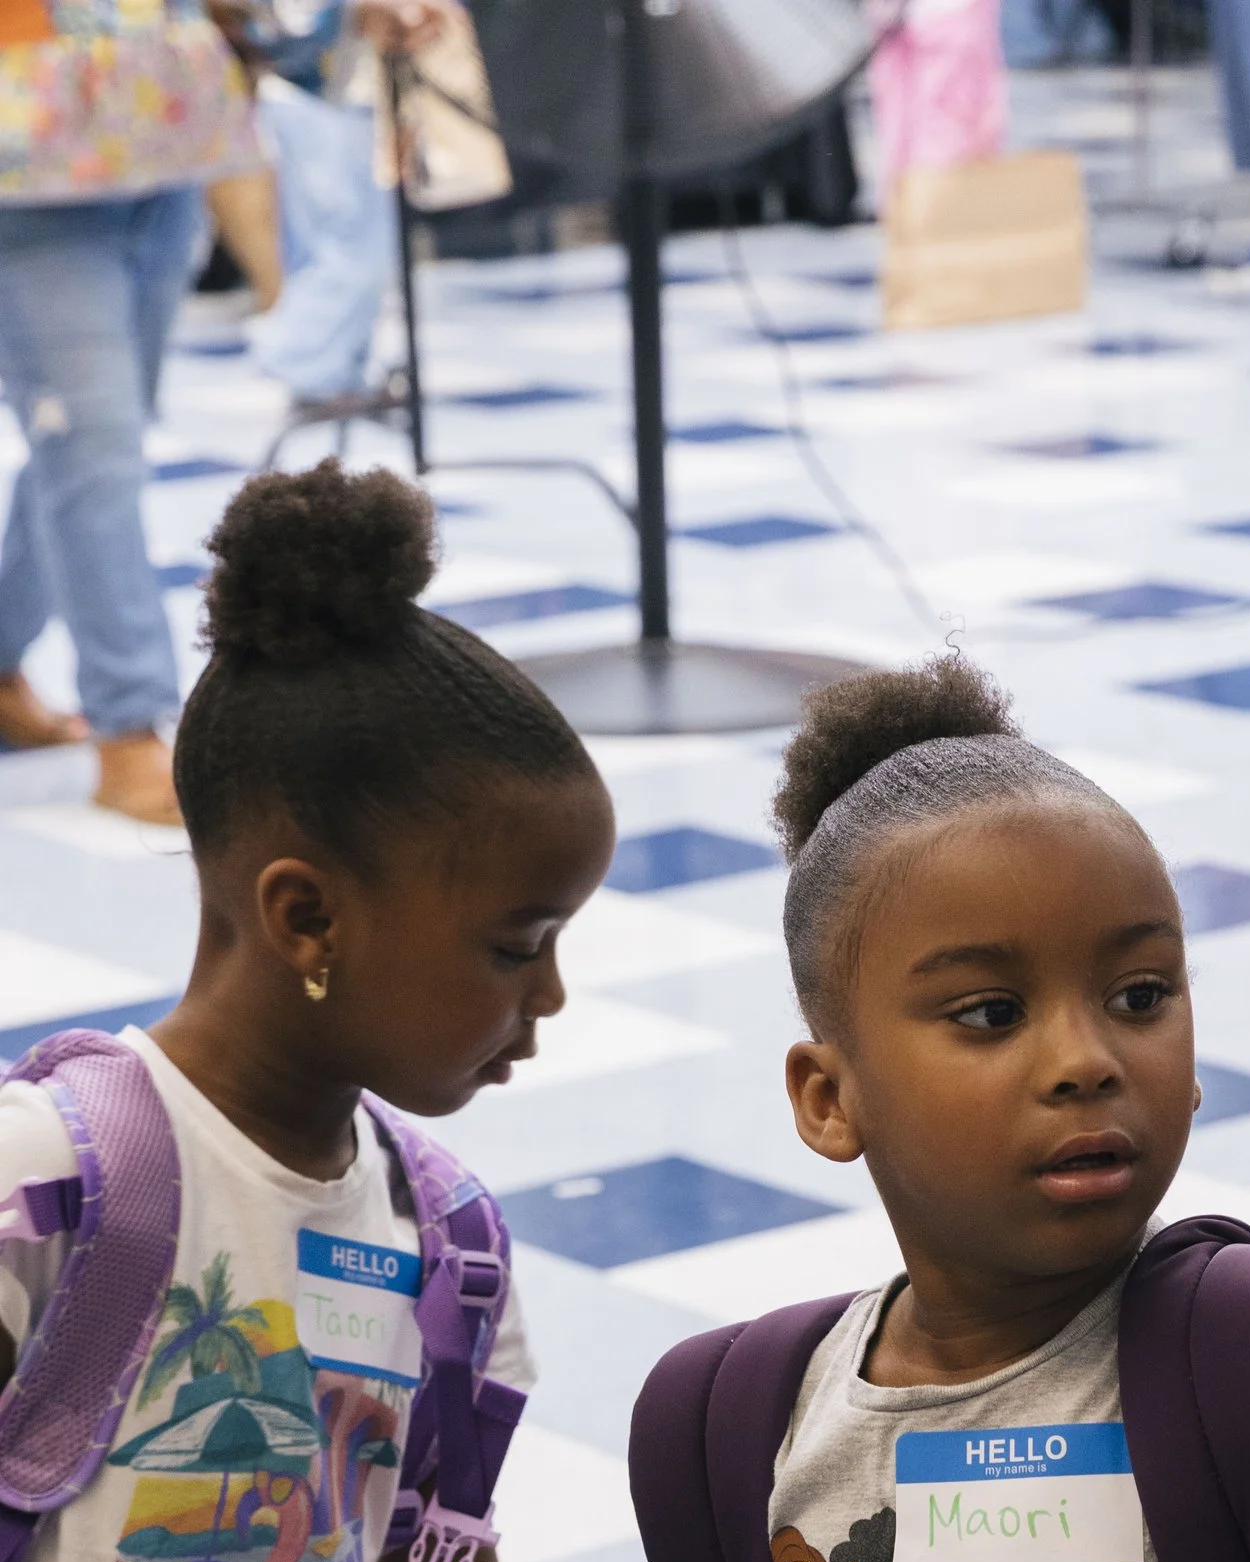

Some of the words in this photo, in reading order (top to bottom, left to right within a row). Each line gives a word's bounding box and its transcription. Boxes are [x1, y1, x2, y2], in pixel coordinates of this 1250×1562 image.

[331, 1245, 399, 1278] HELLO
[303, 1292, 387, 1341] Taori
[965, 1435, 1068, 1465] HELLO
[985, 1465, 1002, 1478] my
[1004, 1464, 1035, 1474] name
[1037, 1462, 1047, 1474] is
[928, 1491, 1072, 1548] Maori
